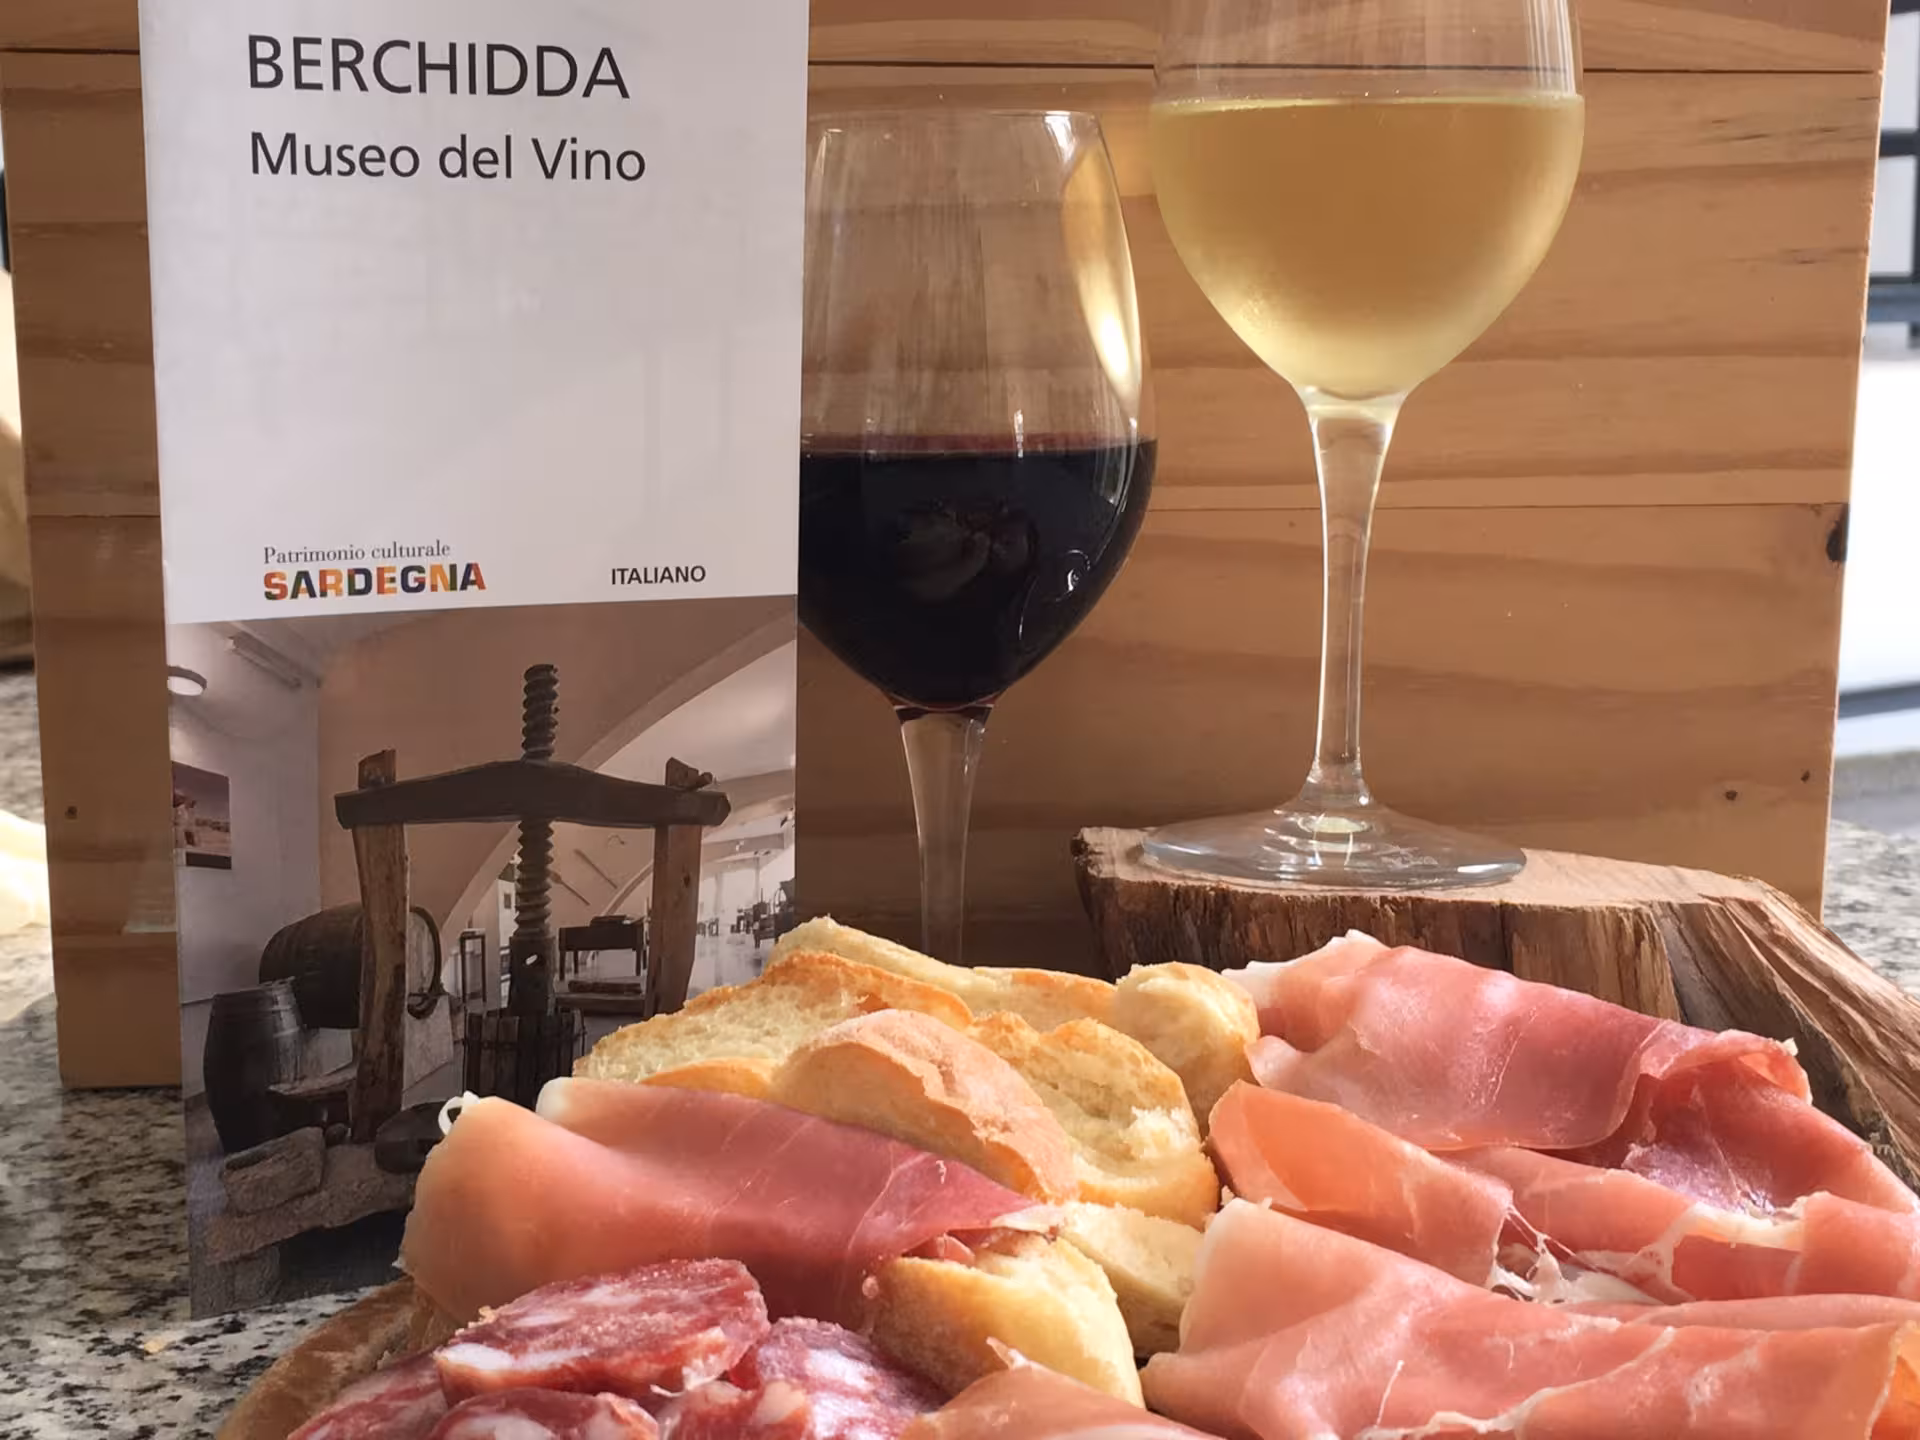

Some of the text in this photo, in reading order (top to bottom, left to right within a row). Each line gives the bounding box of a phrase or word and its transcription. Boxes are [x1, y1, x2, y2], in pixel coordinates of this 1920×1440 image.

[248, 34, 631, 100] BERCHIDDA
[250, 131, 646, 182] Museo del Vino
[263, 539, 451, 565] Patrimonio culturale
[263, 562, 487, 601] SARDEGNA
[611, 565, 707, 586] ITALIANO
